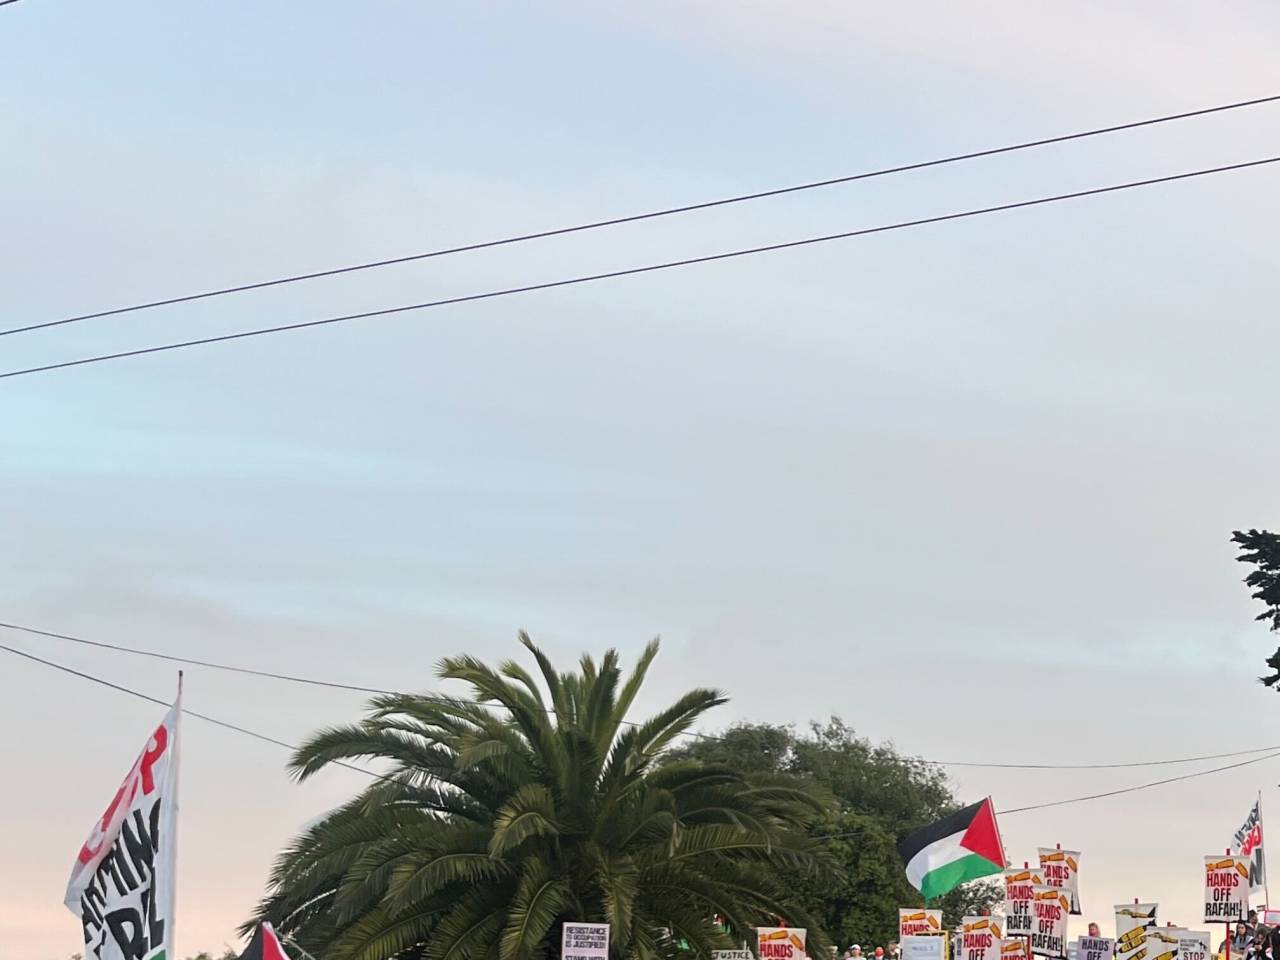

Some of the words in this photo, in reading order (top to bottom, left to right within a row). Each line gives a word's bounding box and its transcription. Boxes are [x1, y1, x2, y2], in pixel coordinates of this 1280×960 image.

[1206, 873, 1239, 888] HANDS
[1007, 885, 1034, 900] HANDS
[1213, 887, 1232, 902] OFF
[1013, 901, 1029, 914] OFF
[1205, 902, 1239, 917] RAFAH!
[1039, 919, 1054, 935] OFF
[963, 933, 992, 948] HANDS
[1031, 934, 1061, 952] RAFAH!
[1082, 939, 1110, 951] HANDS
[713, 952, 750, 960] JUSTICE
[760, 943, 793, 958] HANDS
